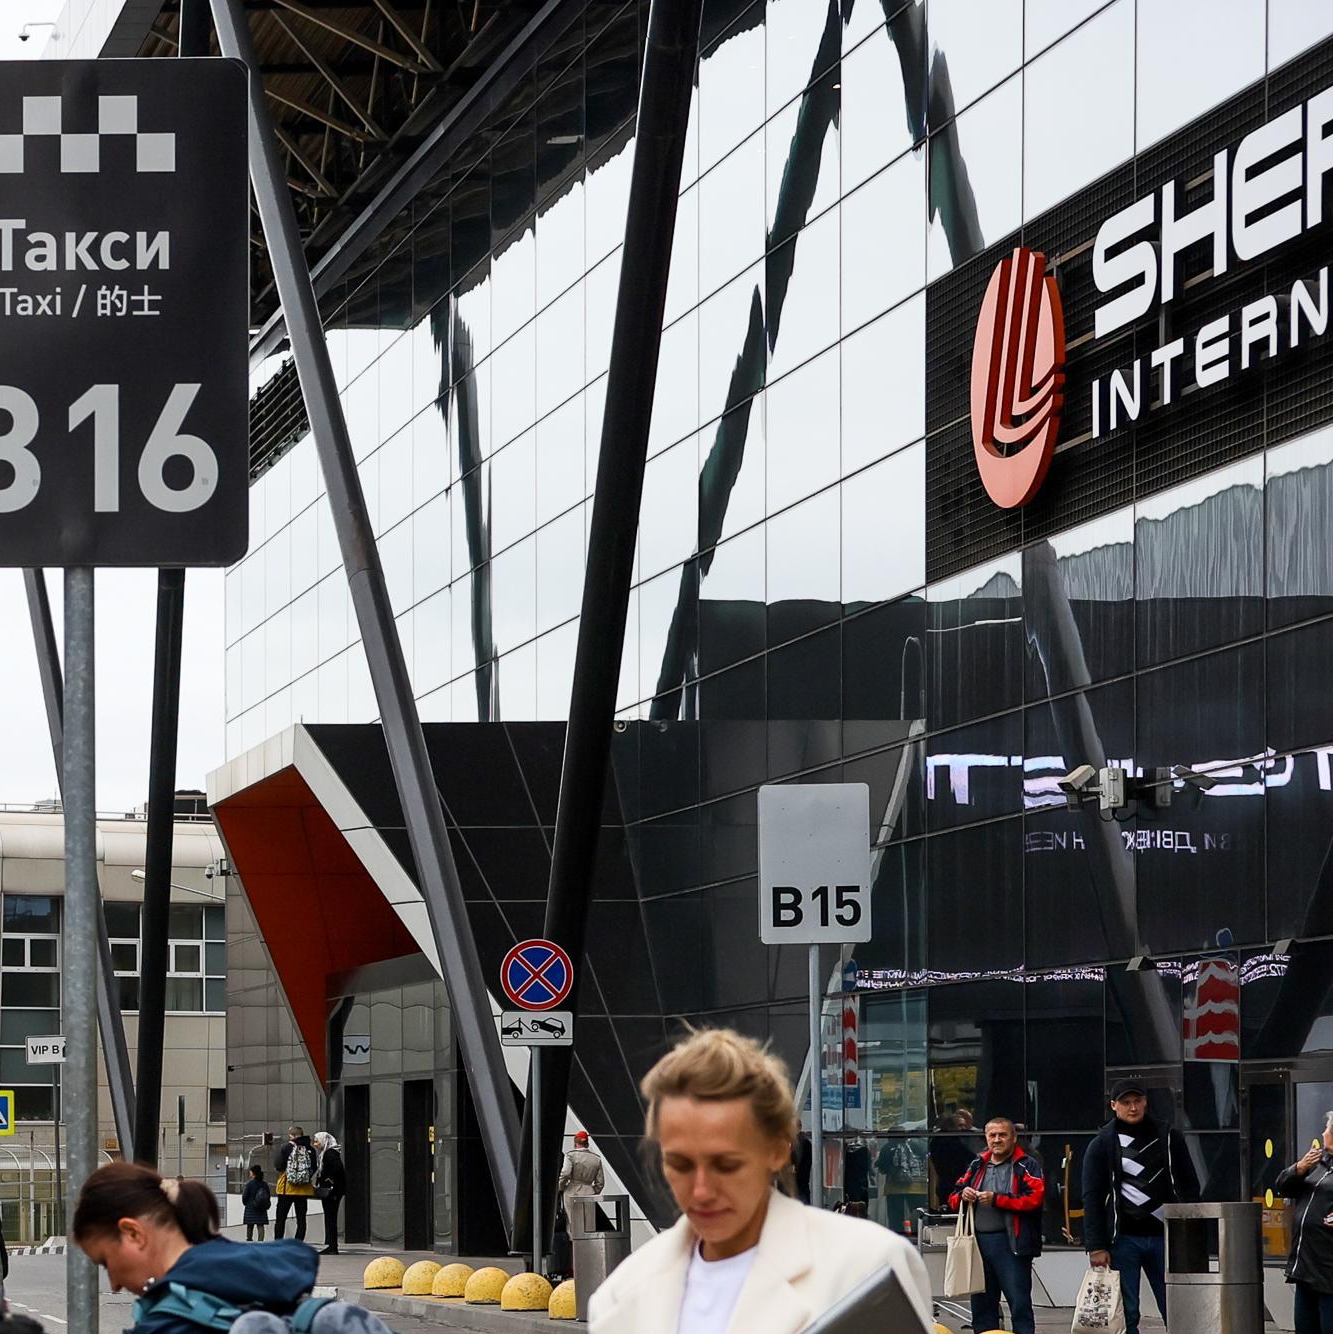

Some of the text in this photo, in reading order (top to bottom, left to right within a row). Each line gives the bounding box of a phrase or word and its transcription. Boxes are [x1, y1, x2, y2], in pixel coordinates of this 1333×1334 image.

[96, 284, 162, 318] 的士
[30, 1044, 60, 1056] VIP B
